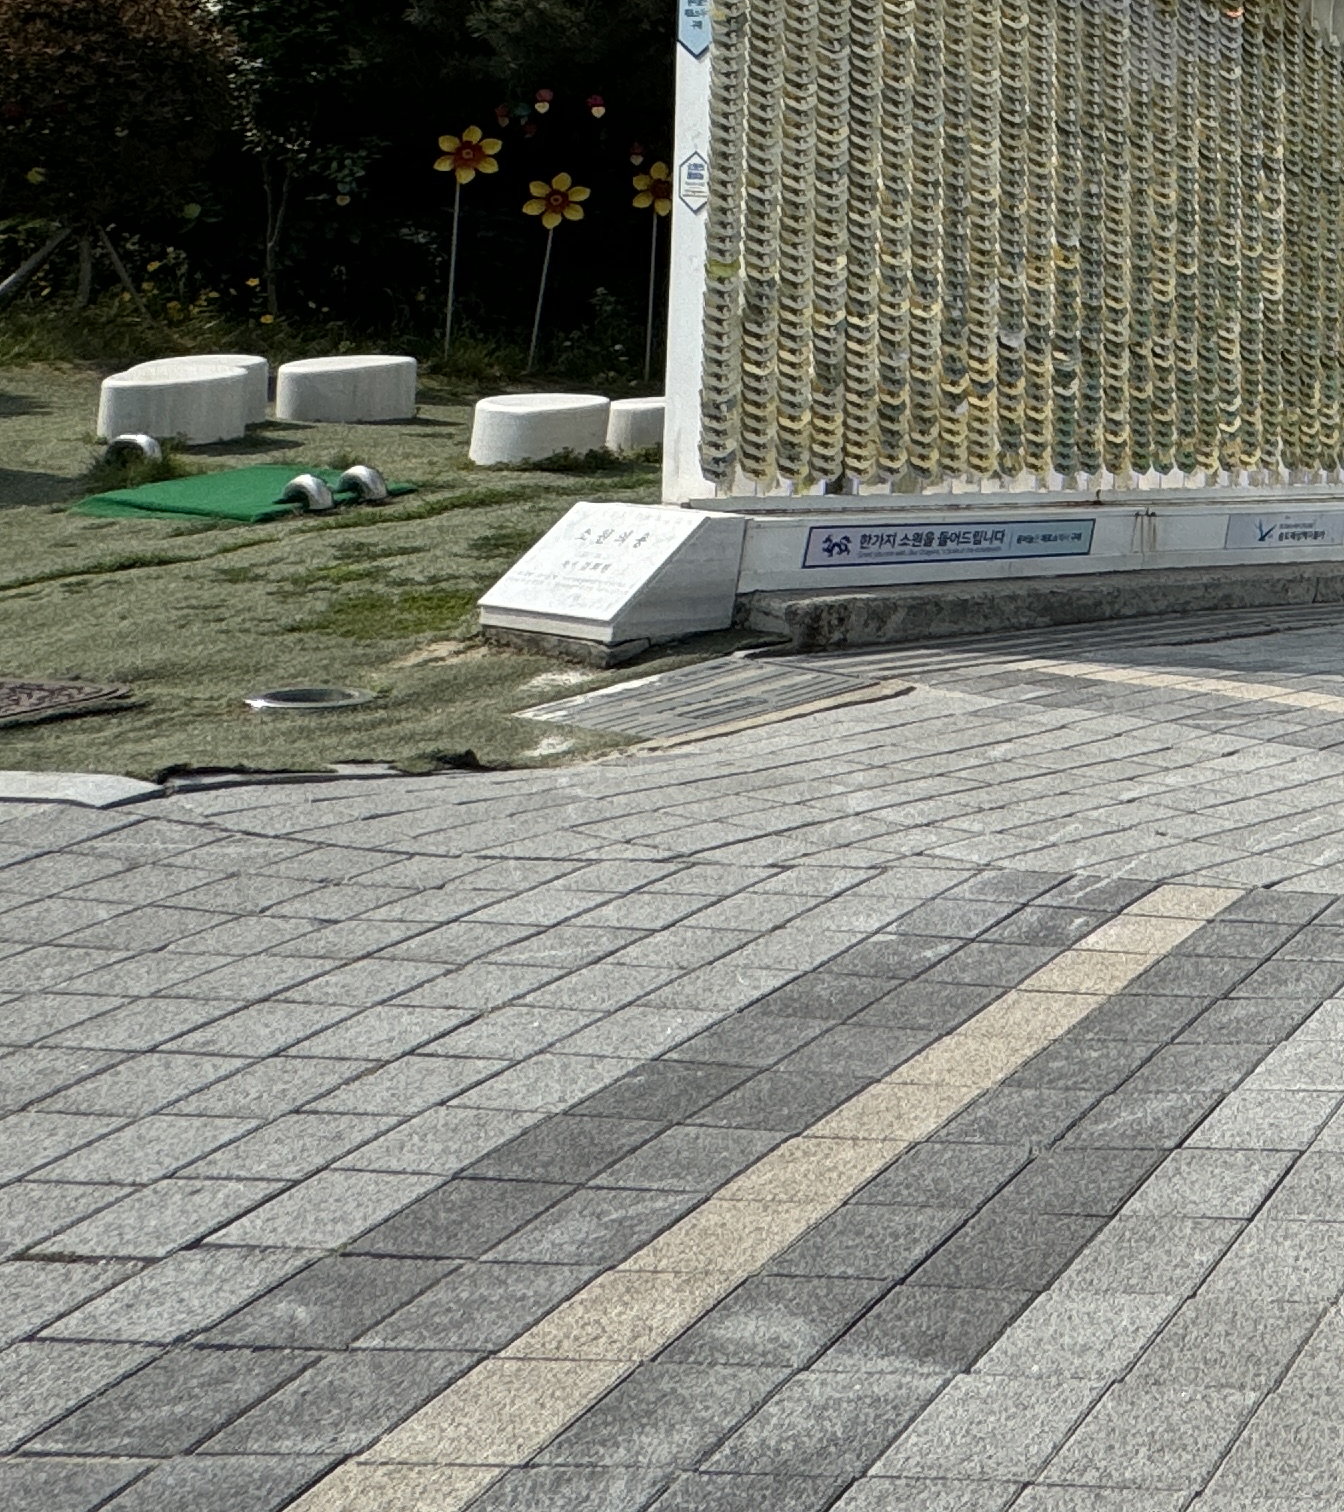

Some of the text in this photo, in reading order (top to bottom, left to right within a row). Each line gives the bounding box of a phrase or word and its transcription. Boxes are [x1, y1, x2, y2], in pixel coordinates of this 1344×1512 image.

[860, 528, 1006, 550] 한가지 소원을 들어드립니다
